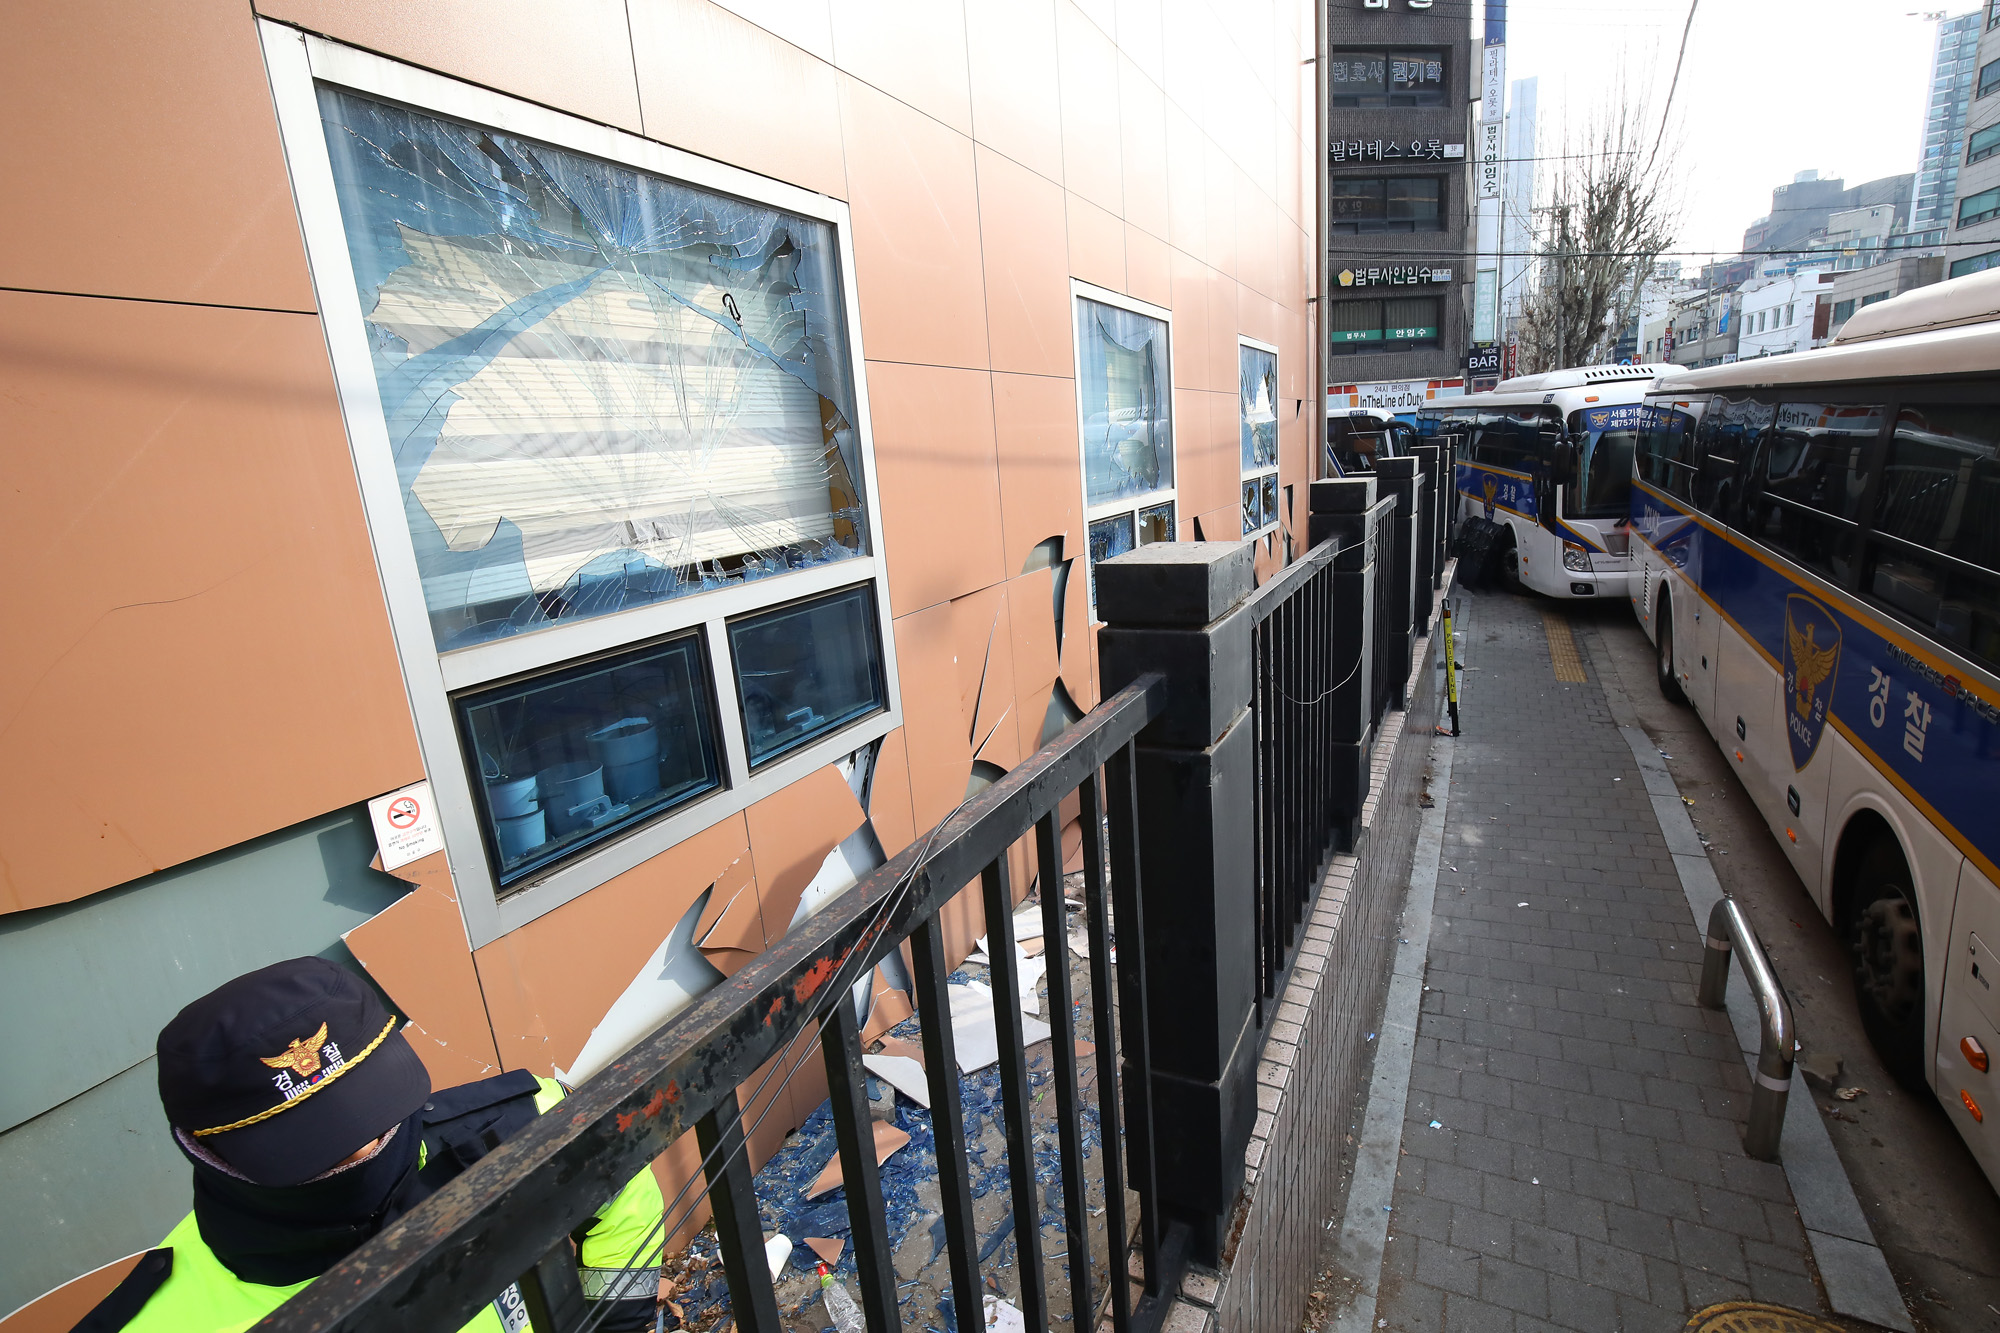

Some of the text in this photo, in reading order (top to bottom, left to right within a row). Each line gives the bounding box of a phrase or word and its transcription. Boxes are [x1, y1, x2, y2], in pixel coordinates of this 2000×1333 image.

[1333, 61, 1443, 82] 변호사 권기학
[1488, 49, 1498, 86] 필라테스
[1488, 88, 1498, 108] 오롯
[1486, 126, 1497, 151] 법무사
[1330, 139, 1443, 161] 필라테스 오롯
[1483, 153, 1497, 192] 안임수
[1346, 328, 1427, 340] 법무사 안임수
[1469, 355, 1498, 368] BAR
[1374, 384, 1411, 393] 24시 편의점
[1397, 393, 1406, 406] of
[1407, 392, 1424, 406] Duty
[1789, 712, 1812, 748] POLICE
